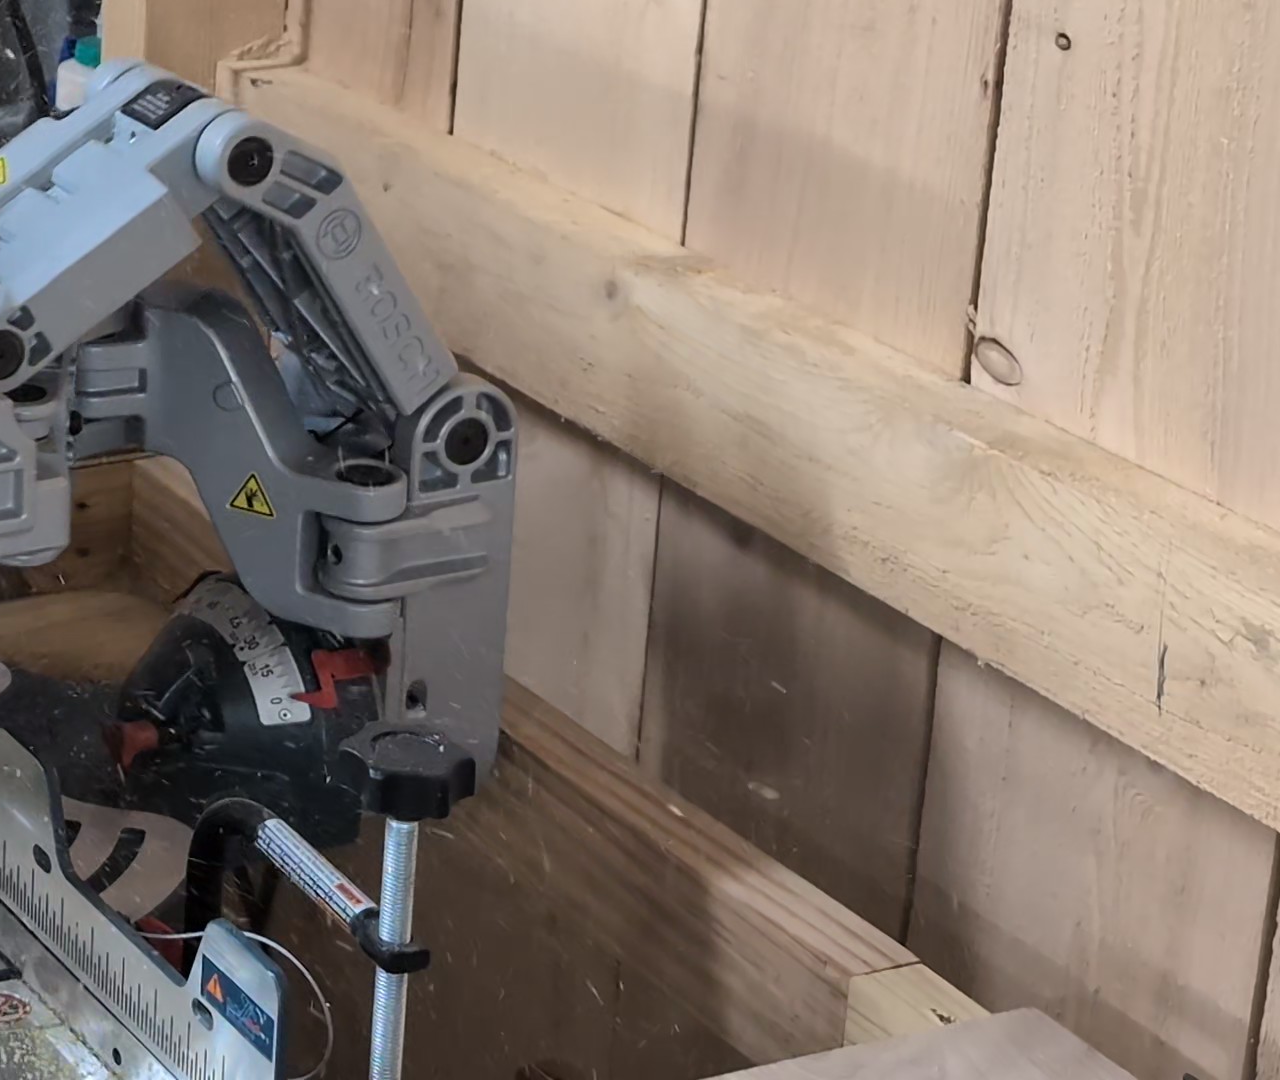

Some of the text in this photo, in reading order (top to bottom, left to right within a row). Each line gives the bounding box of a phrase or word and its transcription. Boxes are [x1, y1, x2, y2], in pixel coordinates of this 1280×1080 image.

[355, 262, 441, 396] BOSCH
[244, 635, 260, 651] 30
[258, 663, 274, 678] 15
[270, 696, 283, 705] 0
